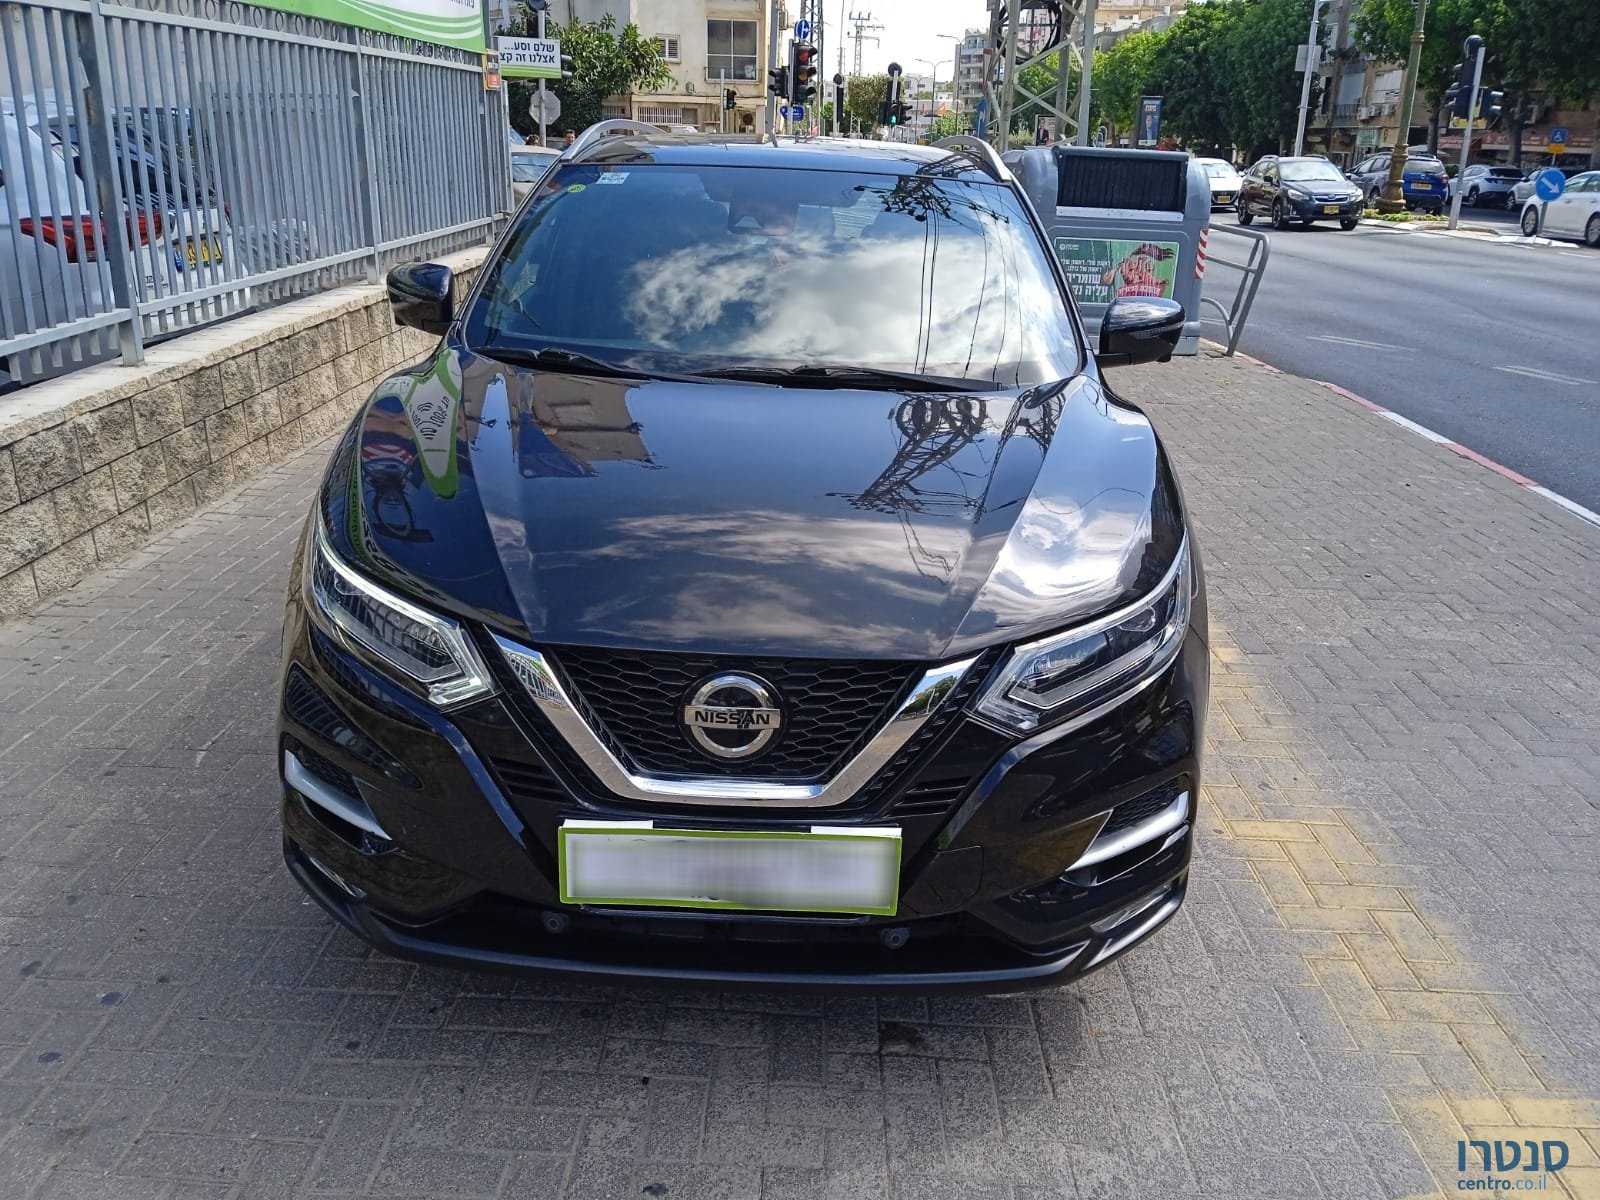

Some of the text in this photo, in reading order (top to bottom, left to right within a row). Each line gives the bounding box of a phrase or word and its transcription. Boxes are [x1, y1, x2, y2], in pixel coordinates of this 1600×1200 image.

[504, 41, 555, 52] שלם וסע...
[515, 53, 526, 62] זה
[528, 52, 555, 64] אצלנו
[694, 710, 770, 725] NISSAN
